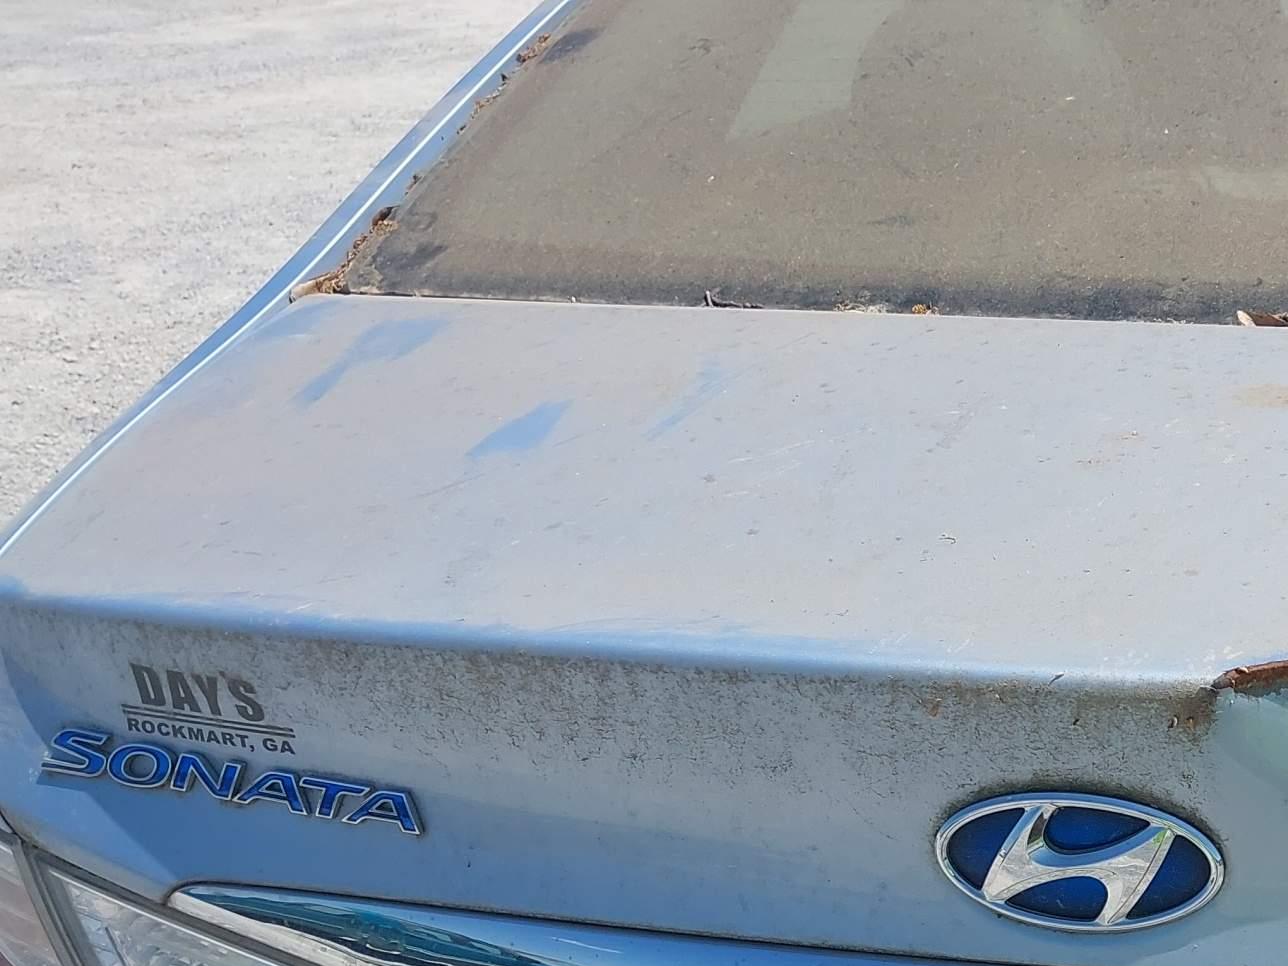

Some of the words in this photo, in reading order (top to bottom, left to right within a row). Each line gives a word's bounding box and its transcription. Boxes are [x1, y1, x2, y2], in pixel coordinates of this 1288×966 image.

[129, 662, 266, 722] DAY'S
[127, 717, 255, 752] ROCKMART,
[261, 737, 296, 756] GA
[41, 728, 423, 836] SONATA
